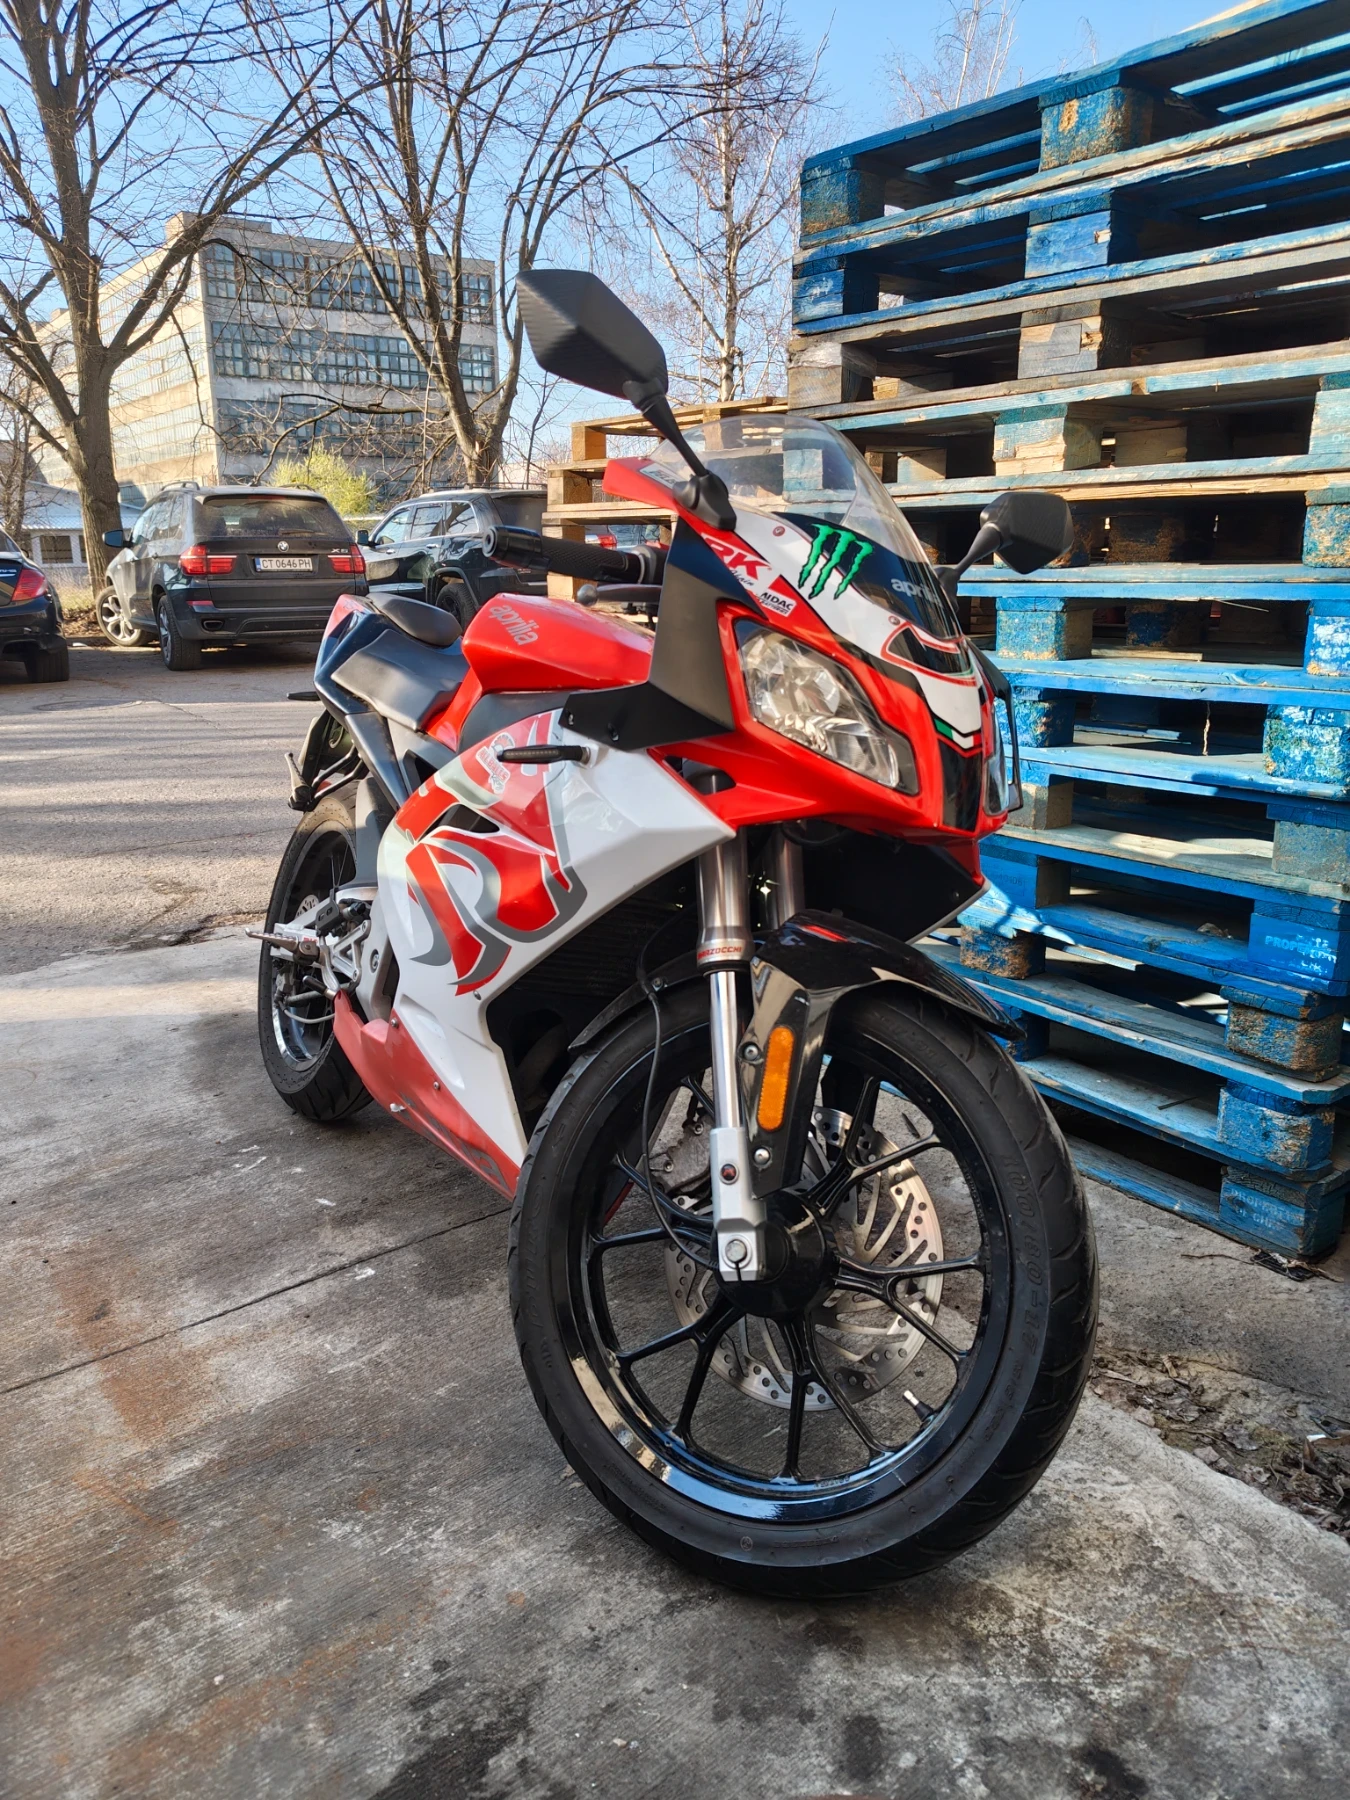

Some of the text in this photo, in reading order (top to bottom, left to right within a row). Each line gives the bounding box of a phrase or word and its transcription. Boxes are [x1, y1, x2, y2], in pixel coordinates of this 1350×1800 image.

[261, 559, 311, 568] CT 0646 PH
[488, 604, 540, 646] aprilia
